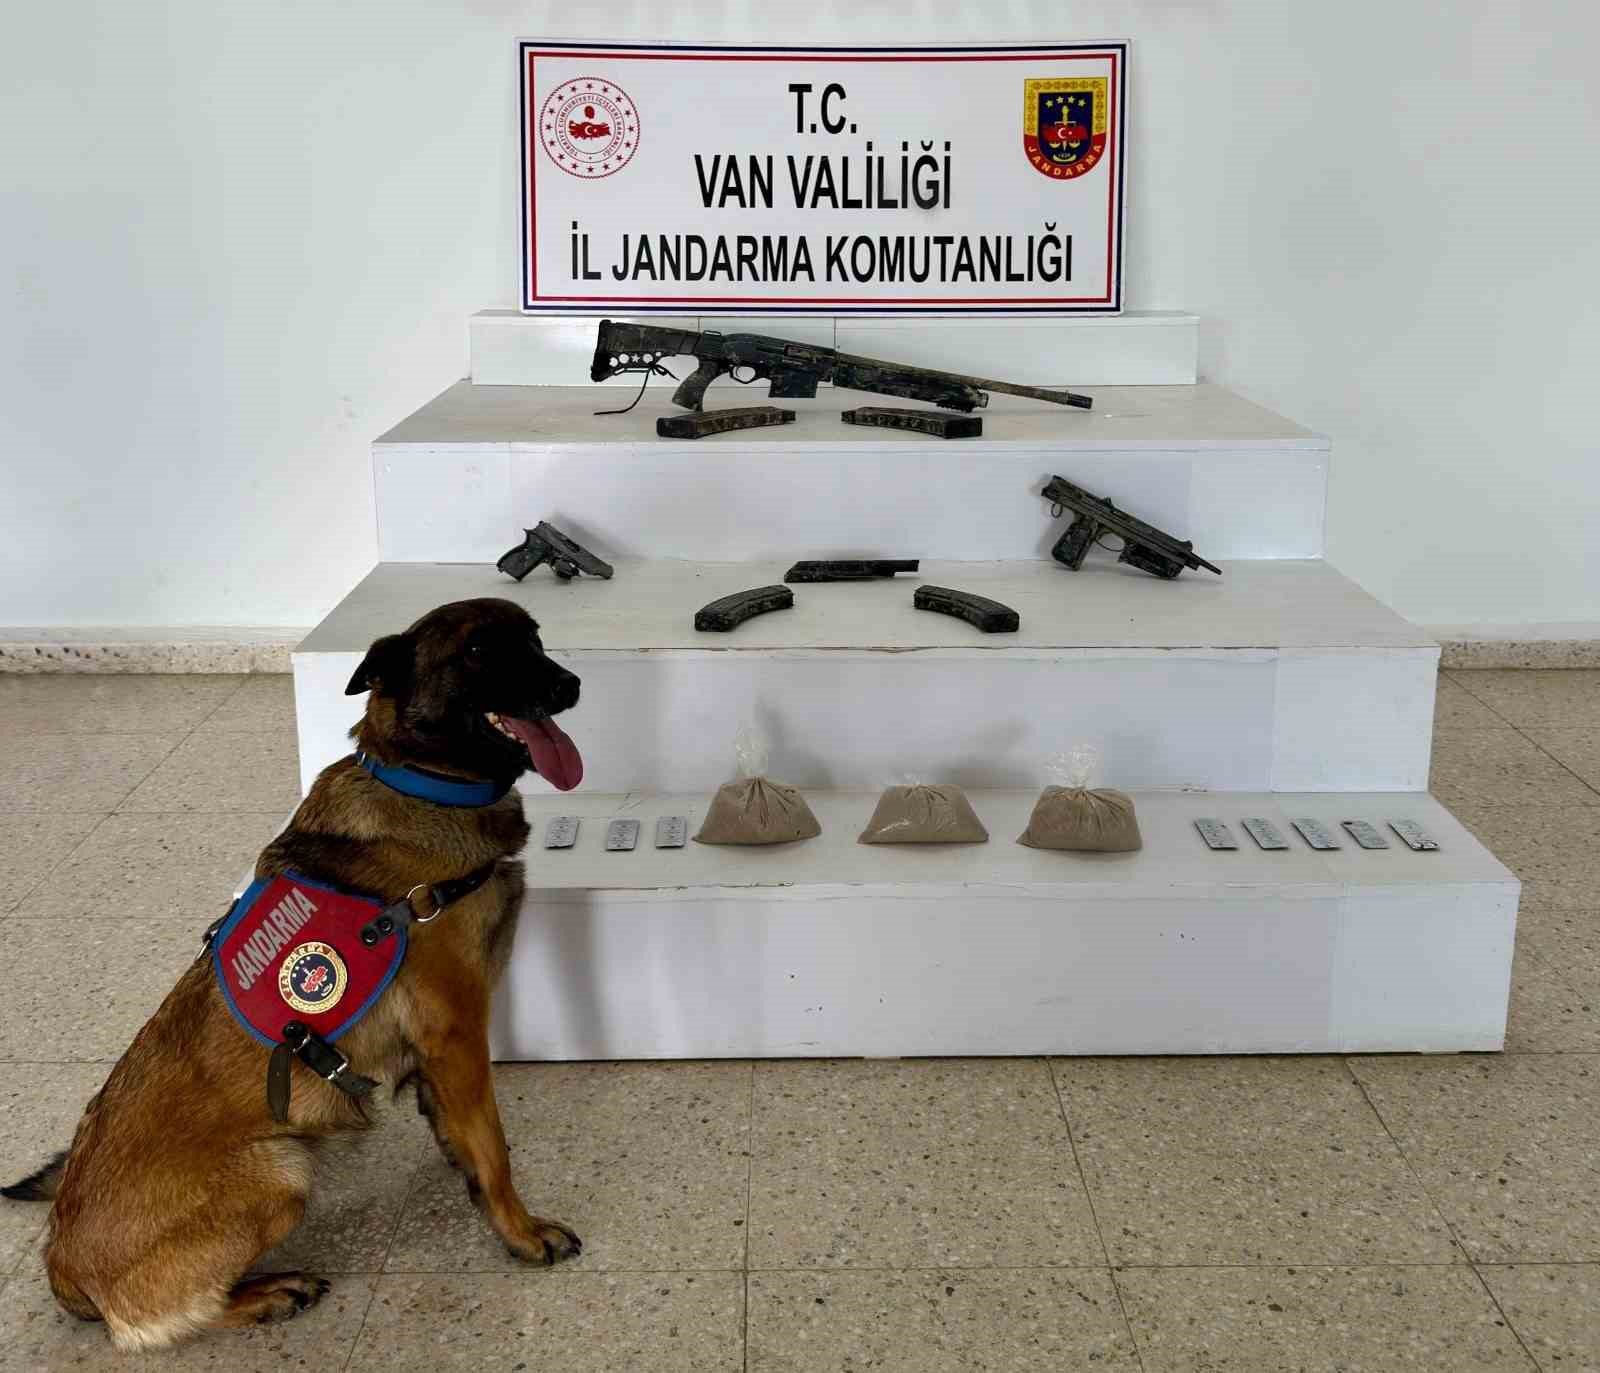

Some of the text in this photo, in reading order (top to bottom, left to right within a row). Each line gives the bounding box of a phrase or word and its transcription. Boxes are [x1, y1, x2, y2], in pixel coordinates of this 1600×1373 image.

[788, 83, 857, 134] T.C.
[694, 140, 951, 210] VAN VALİLİĞİ
[1028, 145, 1102, 176] JANDARMA
[571, 220, 1073, 283] İL JANDARMA KOMUTANLIĞI
[231, 887, 319, 991] JANDARMA
